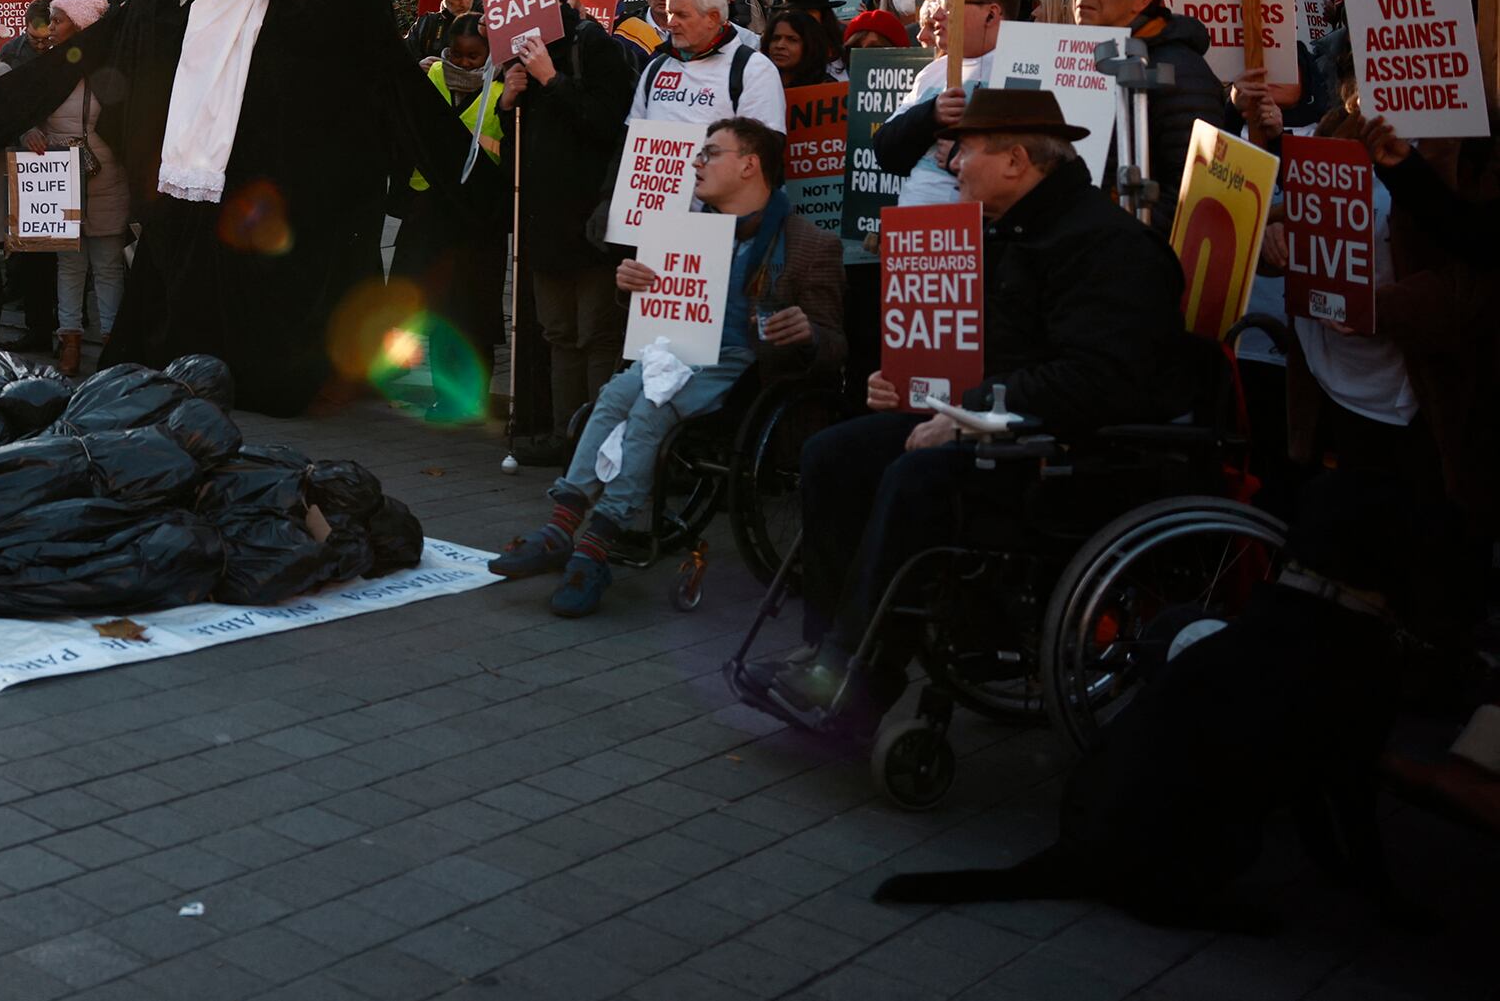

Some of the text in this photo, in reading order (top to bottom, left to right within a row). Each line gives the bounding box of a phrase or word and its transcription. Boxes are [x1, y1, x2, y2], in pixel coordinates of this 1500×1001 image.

[1058, 40, 1068, 52] IT
[1366, 20, 1457, 52] AGAINST
[1012, 62, 1039, 75] £4,188
[1055, 57, 1075, 70] OUR
[1365, 52, 1469, 83] ASSISTED
[867, 69, 914, 90] CHOICE
[1055, 74, 1107, 91] FOR LONG.
[653, 89, 715, 106] dead yet
[857, 92, 895, 112] FOR A
[1373, 84, 1467, 112] SUICIDE.
[633, 137, 695, 158] IT WON'T
[790, 140, 817, 156] IT'S
[17, 161, 69, 173] DIGNITY
[634, 156, 685, 176] BE OUR
[790, 160, 813, 173] TO
[1286, 159, 1366, 191] ASSIST
[22, 181, 66, 192] IS LIFE
[630, 174, 681, 194] CHOICE
[803, 185, 829, 197] NOT
[852, 171, 877, 192] FOR
[31, 203, 58, 214] NOT
[637, 193, 665, 211] FOR
[1287, 192, 1369, 232] US TO
[23, 222, 66, 233] DEATH
[886, 229, 975, 253] THE BILL
[664, 253, 701, 274] IF IN
[886, 255, 976, 272] SAFEGUARDS
[1289, 232, 1369, 285] LIVE
[650, 275, 708, 302] DOUBT,
[885, 273, 977, 303] ARENT
[641, 297, 712, 324] VOTE NO.
[884, 308, 979, 350] SAFE
